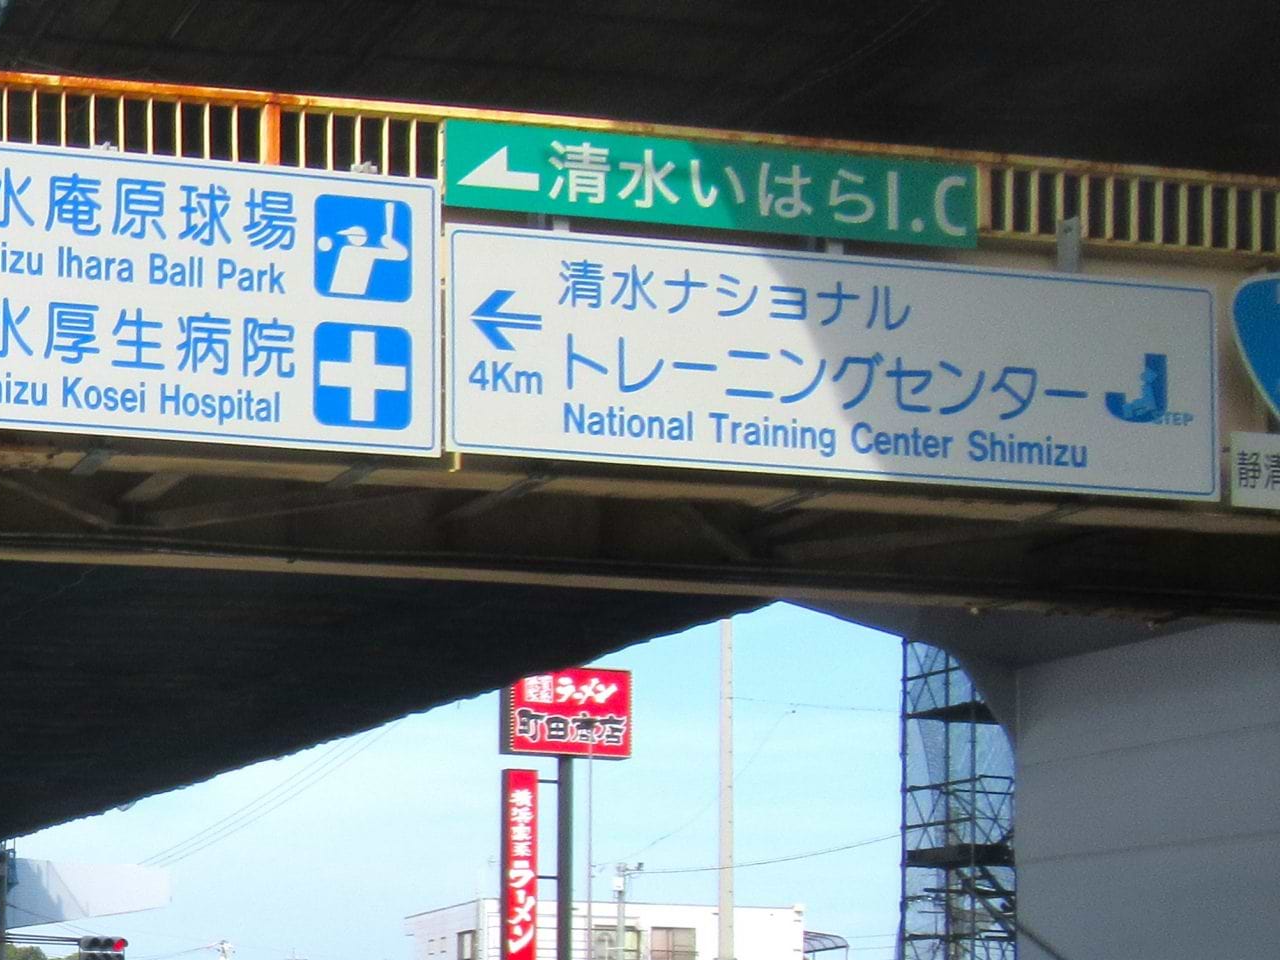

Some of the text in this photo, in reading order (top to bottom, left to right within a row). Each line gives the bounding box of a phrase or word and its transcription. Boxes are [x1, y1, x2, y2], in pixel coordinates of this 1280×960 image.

[57, 246, 134, 283] Ihara
[149, 252, 204, 288] Ball
[218, 258, 287, 295] Park
[558, 259, 911, 331] 清水ナショナル
[62, 376, 146, 414] Kosei
[160, 382, 281, 426] Hospital
[468, 359, 544, 396] 4Km
[566, 332, 1089, 420] トレーニングセンター
[563, 402, 1089, 469] National Training Center Shimizu
